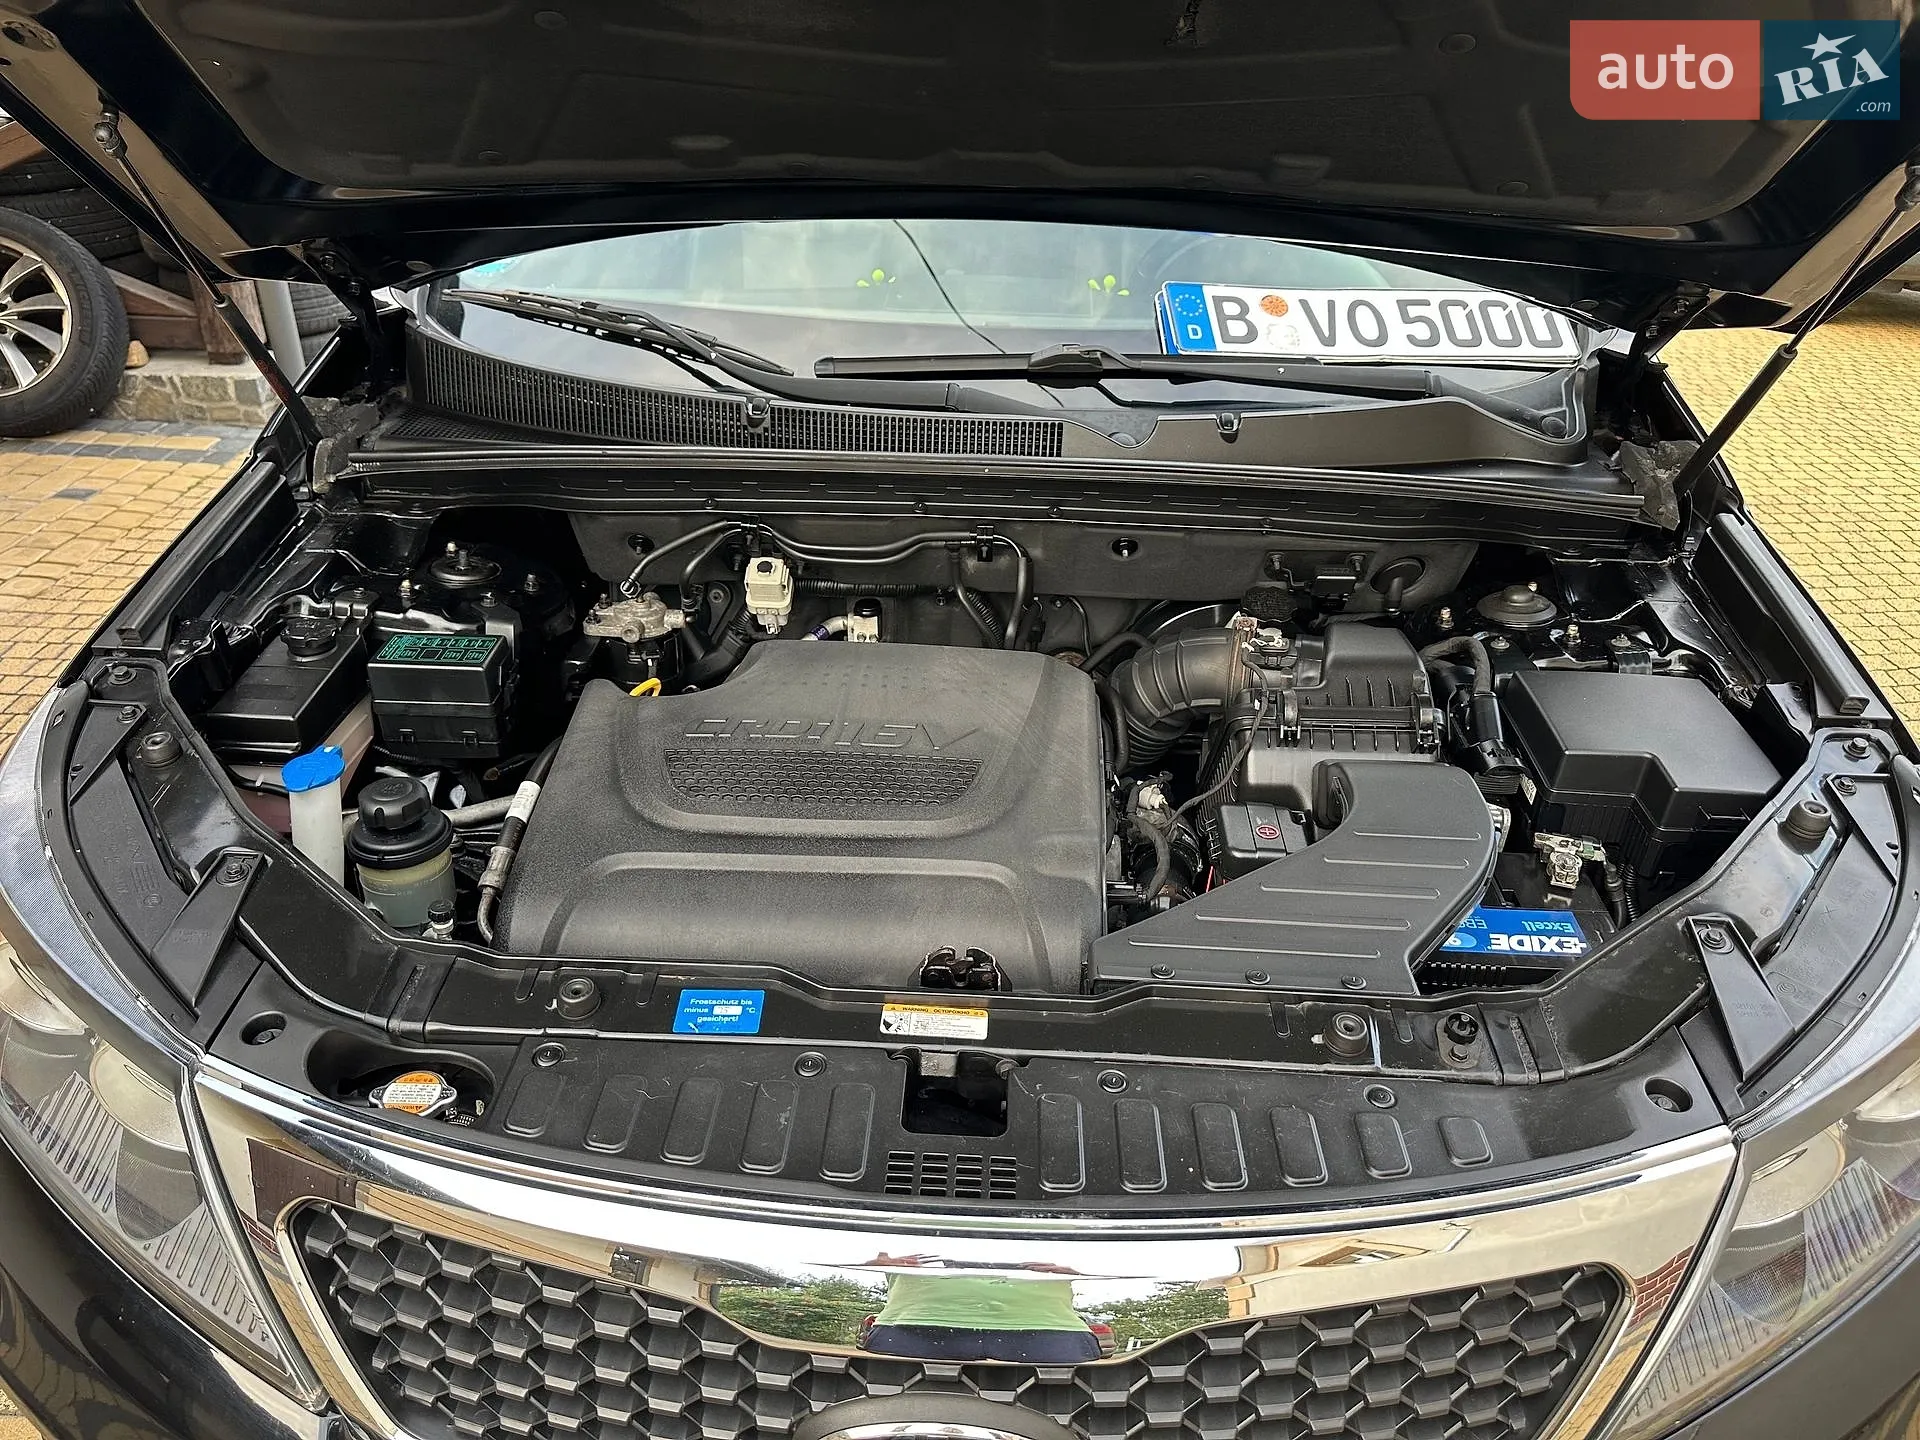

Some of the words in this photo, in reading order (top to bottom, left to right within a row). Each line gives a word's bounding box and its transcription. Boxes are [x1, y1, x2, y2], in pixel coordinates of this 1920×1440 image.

[1210, 295, 1259, 345] B
[1298, 297, 1389, 348] VO
[1395, 298, 1564, 349] 5000
[1186, 323, 1203, 340] D
[1521, 920, 1575, 933] Excell
[1489, 933, 1587, 954] EXIDE
[696, 1015, 739, 1023] gesichert!
